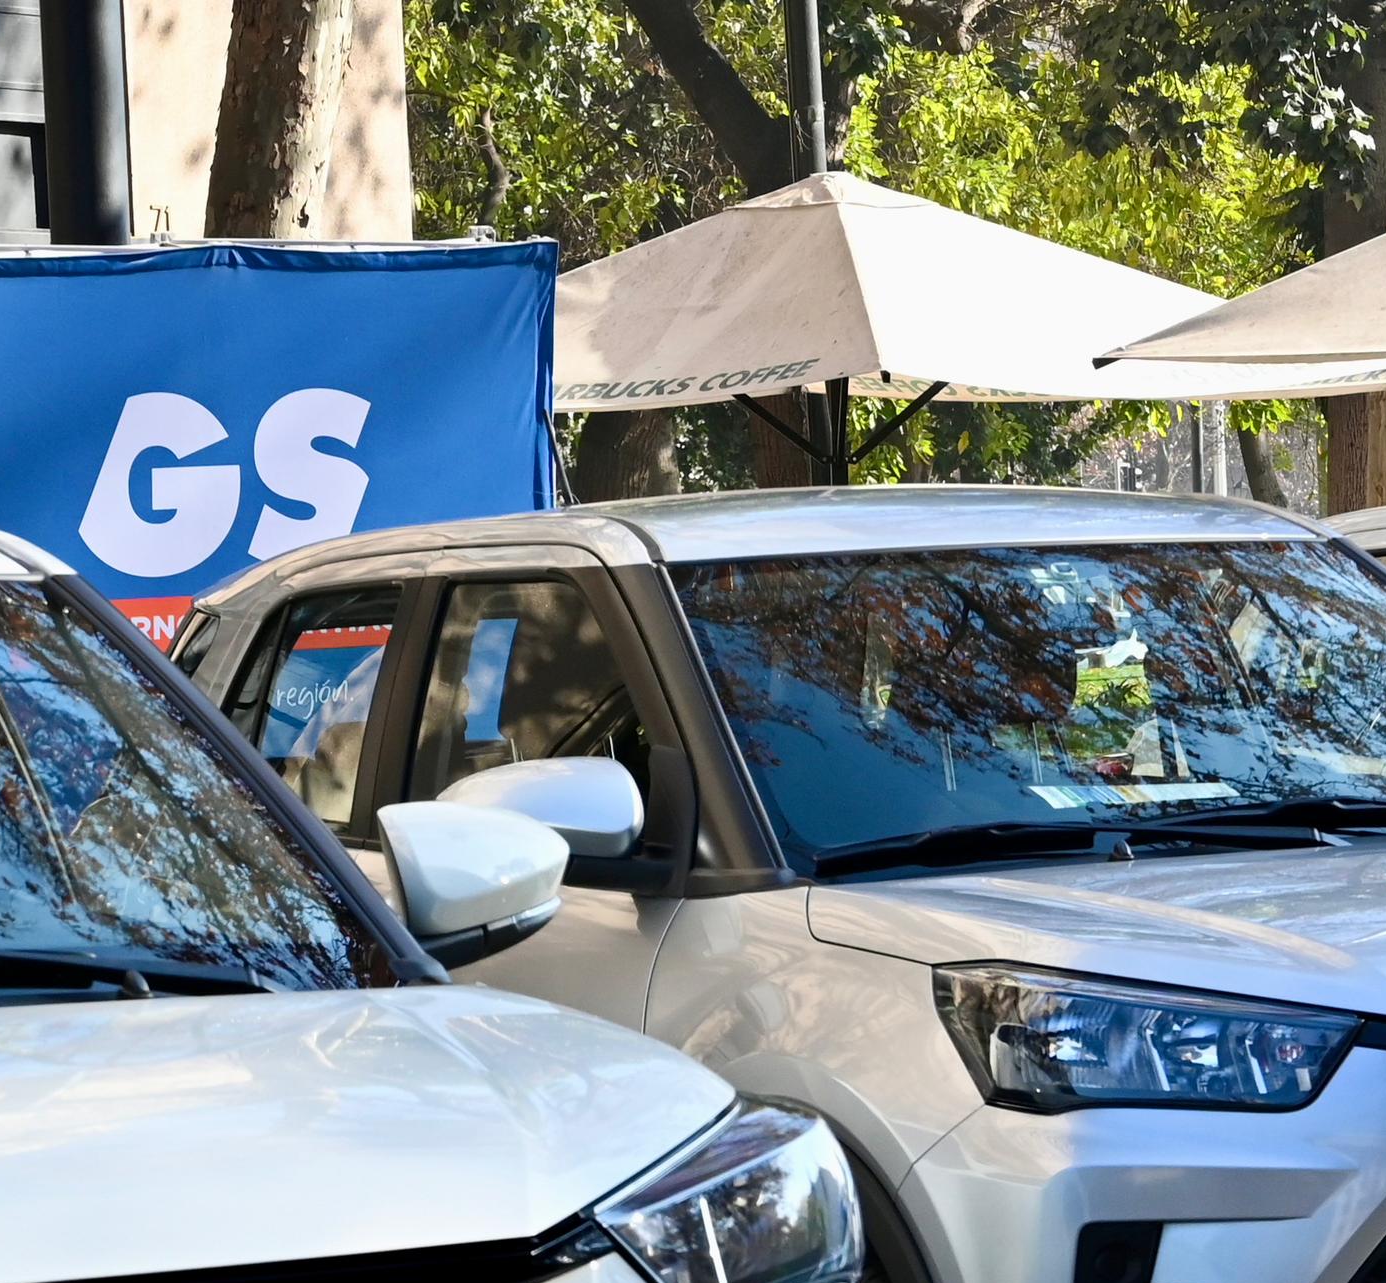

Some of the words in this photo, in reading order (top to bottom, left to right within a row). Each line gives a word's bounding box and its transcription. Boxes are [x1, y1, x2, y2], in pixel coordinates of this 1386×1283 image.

[554, 376, 698, 400] RBUCKS
[699, 358, 821, 392] COFFEE
[78, 387, 372, 578] GS
[276, 679, 354, 720] región.
